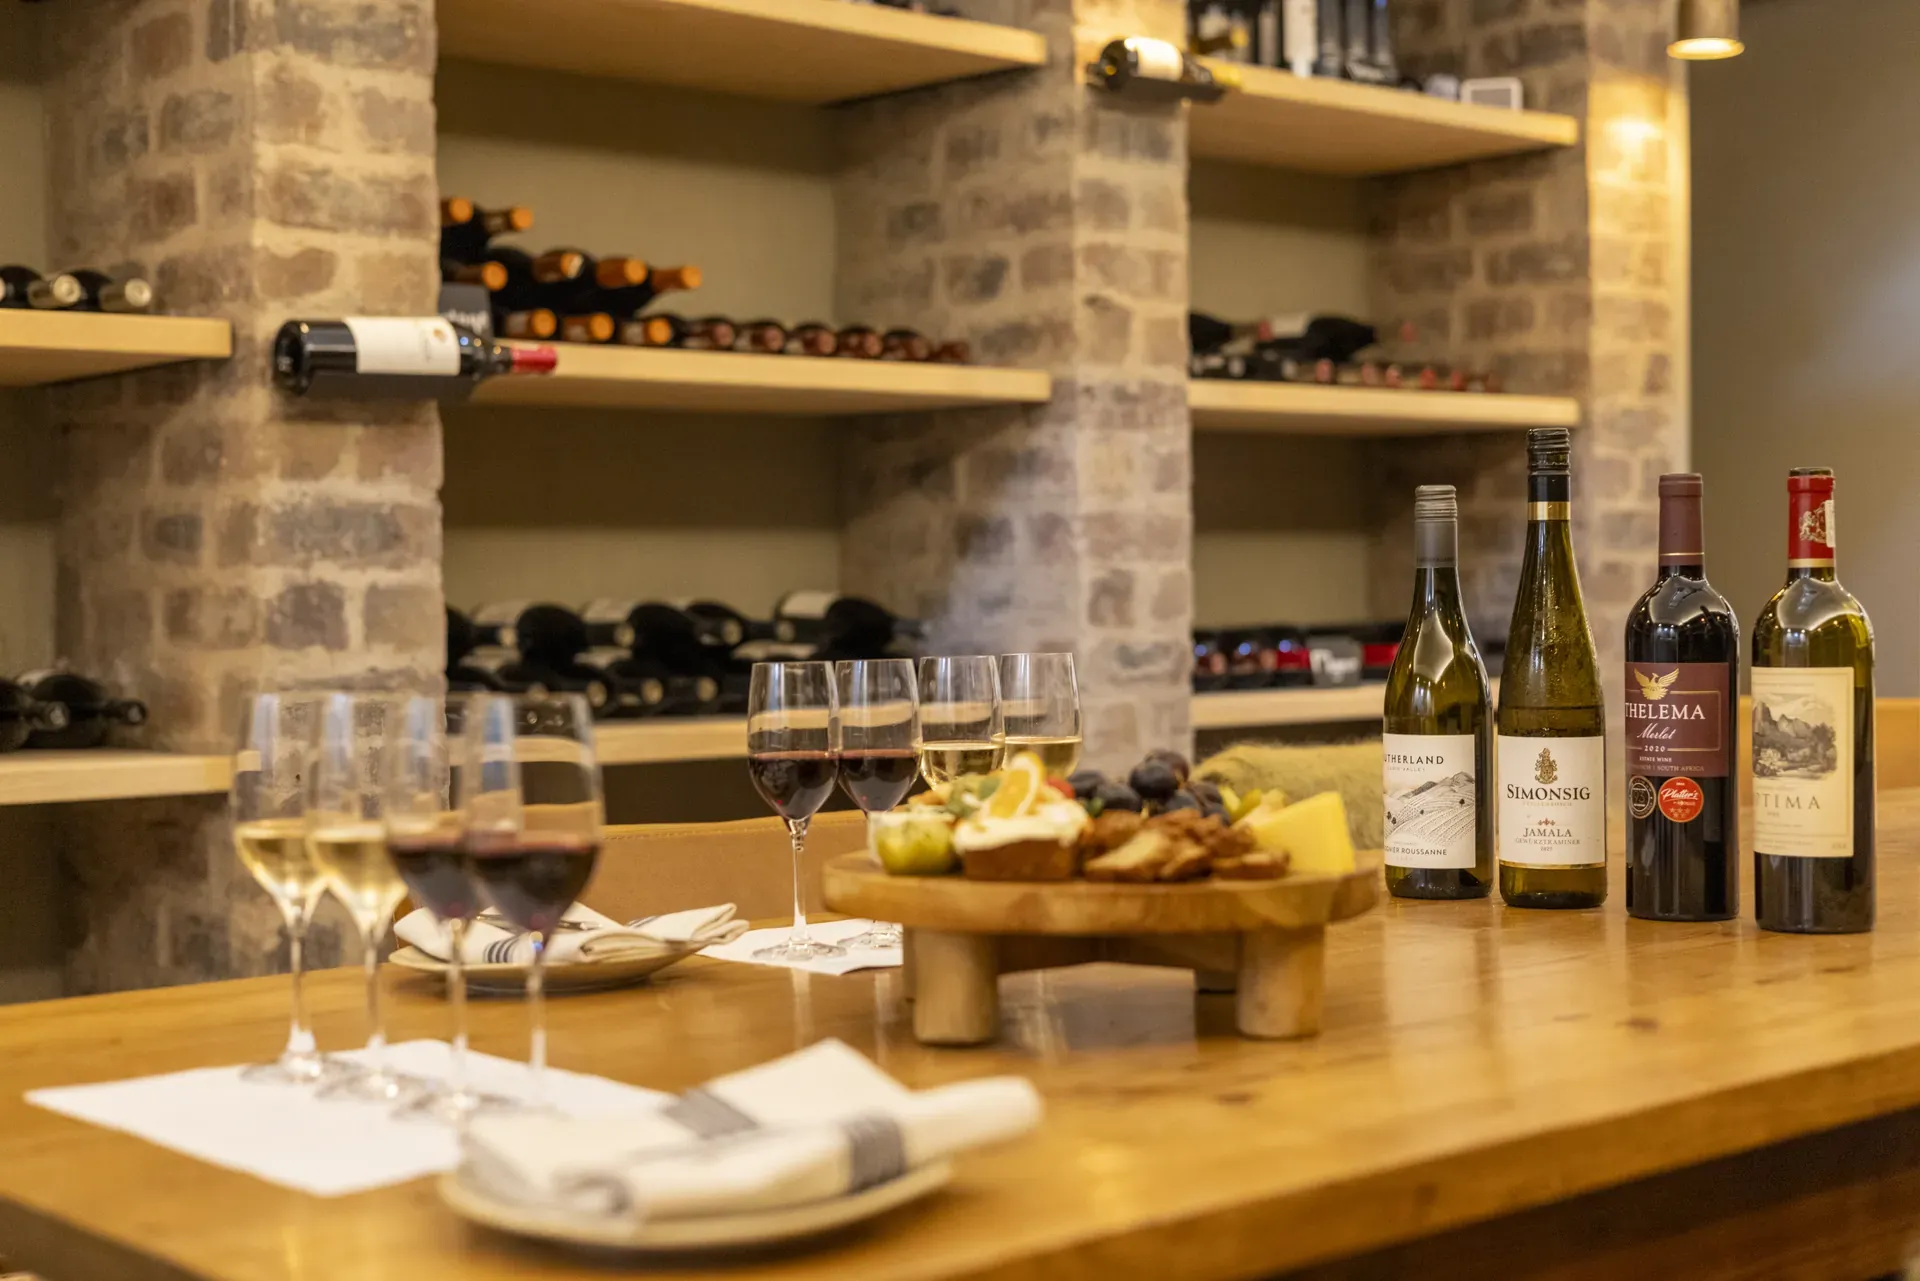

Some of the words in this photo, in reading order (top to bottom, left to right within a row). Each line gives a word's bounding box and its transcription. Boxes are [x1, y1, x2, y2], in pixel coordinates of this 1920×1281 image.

[1625, 702, 1706, 720] THELEMA
[1636, 722, 1677, 740] Merlot
[1644, 745, 1666, 753] 2020
[1507, 783, 1591, 801] SIMONSIG
[1660, 787, 1699, 801] Platter's
[1523, 828, 1572, 838] JAMALA
[1401, 847, 1447, 856] ROUSSANNE
